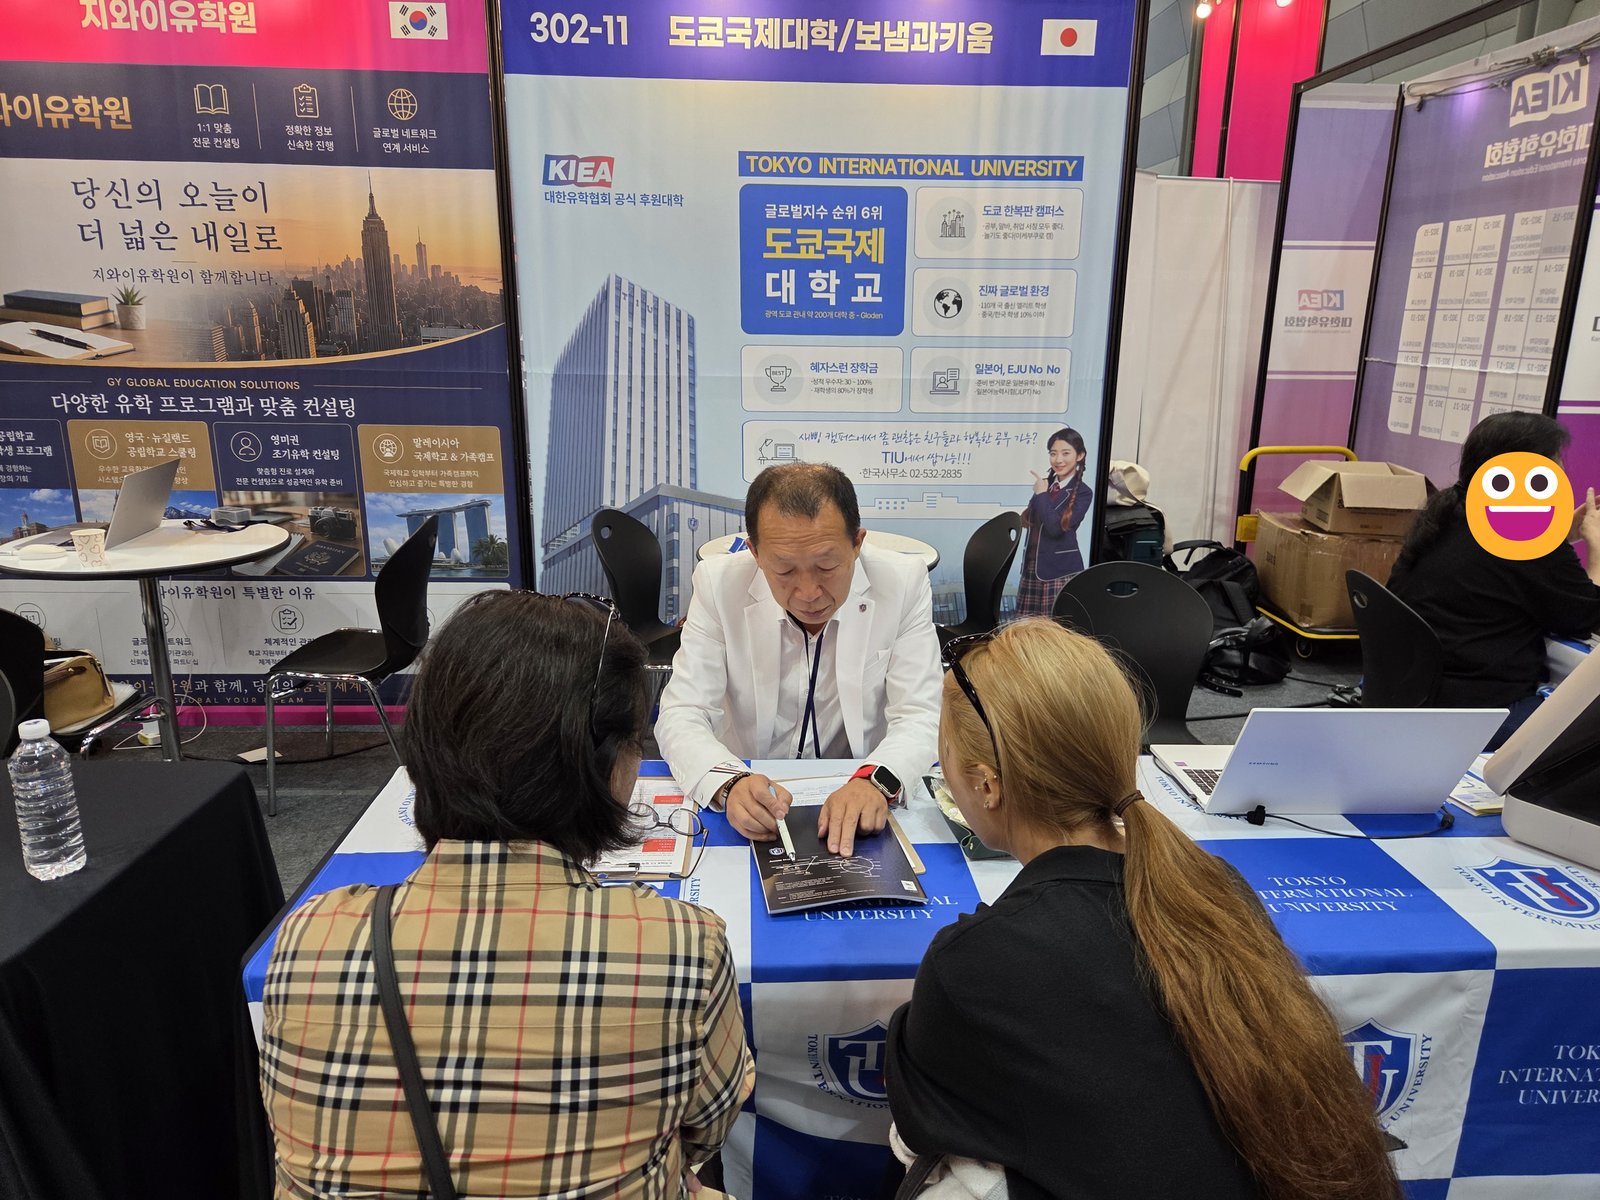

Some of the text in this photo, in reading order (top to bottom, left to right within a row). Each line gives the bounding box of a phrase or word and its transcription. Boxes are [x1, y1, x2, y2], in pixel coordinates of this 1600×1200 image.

[80, 0, 257, 34] 지와이유학원
[530, 12, 629, 46] 302-11
[669, 15, 994, 54] 도쿄국제대학/보냄과키움
[197, 123, 232, 134] 1:1 맞춤
[285, 125, 333, 136] 정확한 정보
[372, 128, 437, 140] 글로벌 네트워크
[192, 137, 240, 149] 전문 컨설팅
[287, 139, 334, 152] 신속한 진행
[382, 142, 430, 154] 연계 서비스
[547, 156, 613, 184] KIEA
[746, 155, 1078, 177] TOKYO INTERNATIONAL UNIVERSITY
[70, 177, 269, 214] 당신의 오늘이
[544, 190, 684, 208] 대한유학협회 공식 후원대학
[765, 204, 883, 221] 글로벌지수 순위 6위
[982, 205, 1064, 217] 도쿄 한복판 캠퍼스
[77, 218, 283, 253] 더 넓은 내일로
[763, 228, 885, 264] 도쿄국제
[92, 267, 278, 286] 지와이유학원이 함께합니다.
[979, 285, 1049, 297] 진짜 글로벌 환경
[810, 362, 879, 374] 혜자스런 장학금
[975, 363, 1061, 376] 일본어, EJU No No
[107, 377, 300, 390] GY GLOBAL EDUCATION SOLUTIONS
[51, 393, 356, 418] 다양한 유학 프로그램과 맞춤 컨설팅
[125, 432, 191, 443] 영국 뉴질랜드
[270, 434, 300, 446] 영미권
[413, 437, 460, 449] 말레이시아
[825, 431, 877, 444] 캠퍼스에서
[892, 429, 921, 445] 괜찮은
[924, 430, 960, 447] 친구들과
[963, 431, 993, 448] 행복한
[995, 432, 1011, 447] 공부
[1015, 432, 1038, 445] 가능?
[16, 445, 53, 457] 프로그램
[127, 446, 196, 458] 공립학교 스쿨링
[272, 449, 340, 460] 조기유학 컨설팅
[414, 451, 495, 463] 국제학교 & 가족캠프
[882, 451, 925, 464] TIU에서
[909, 469, 962, 479] 02-532-2835
[242, 586, 284, 600] 특별한
[289, 587, 315, 600] 이유
[264, 638, 297, 646] 체계적인
[214, 680, 248, 693] 함께,
[1268, 876, 1347, 887] TOKYO
[1453, 865, 1493, 894] TOKYO
[1257, 888, 1414, 900] TERNATIONAL
[1267, 901, 1400, 913] UNIVERSITY
[804, 909, 934, 922] UNIVERSITY
[1390, 1033, 1433, 1121] UNIVERSITY
